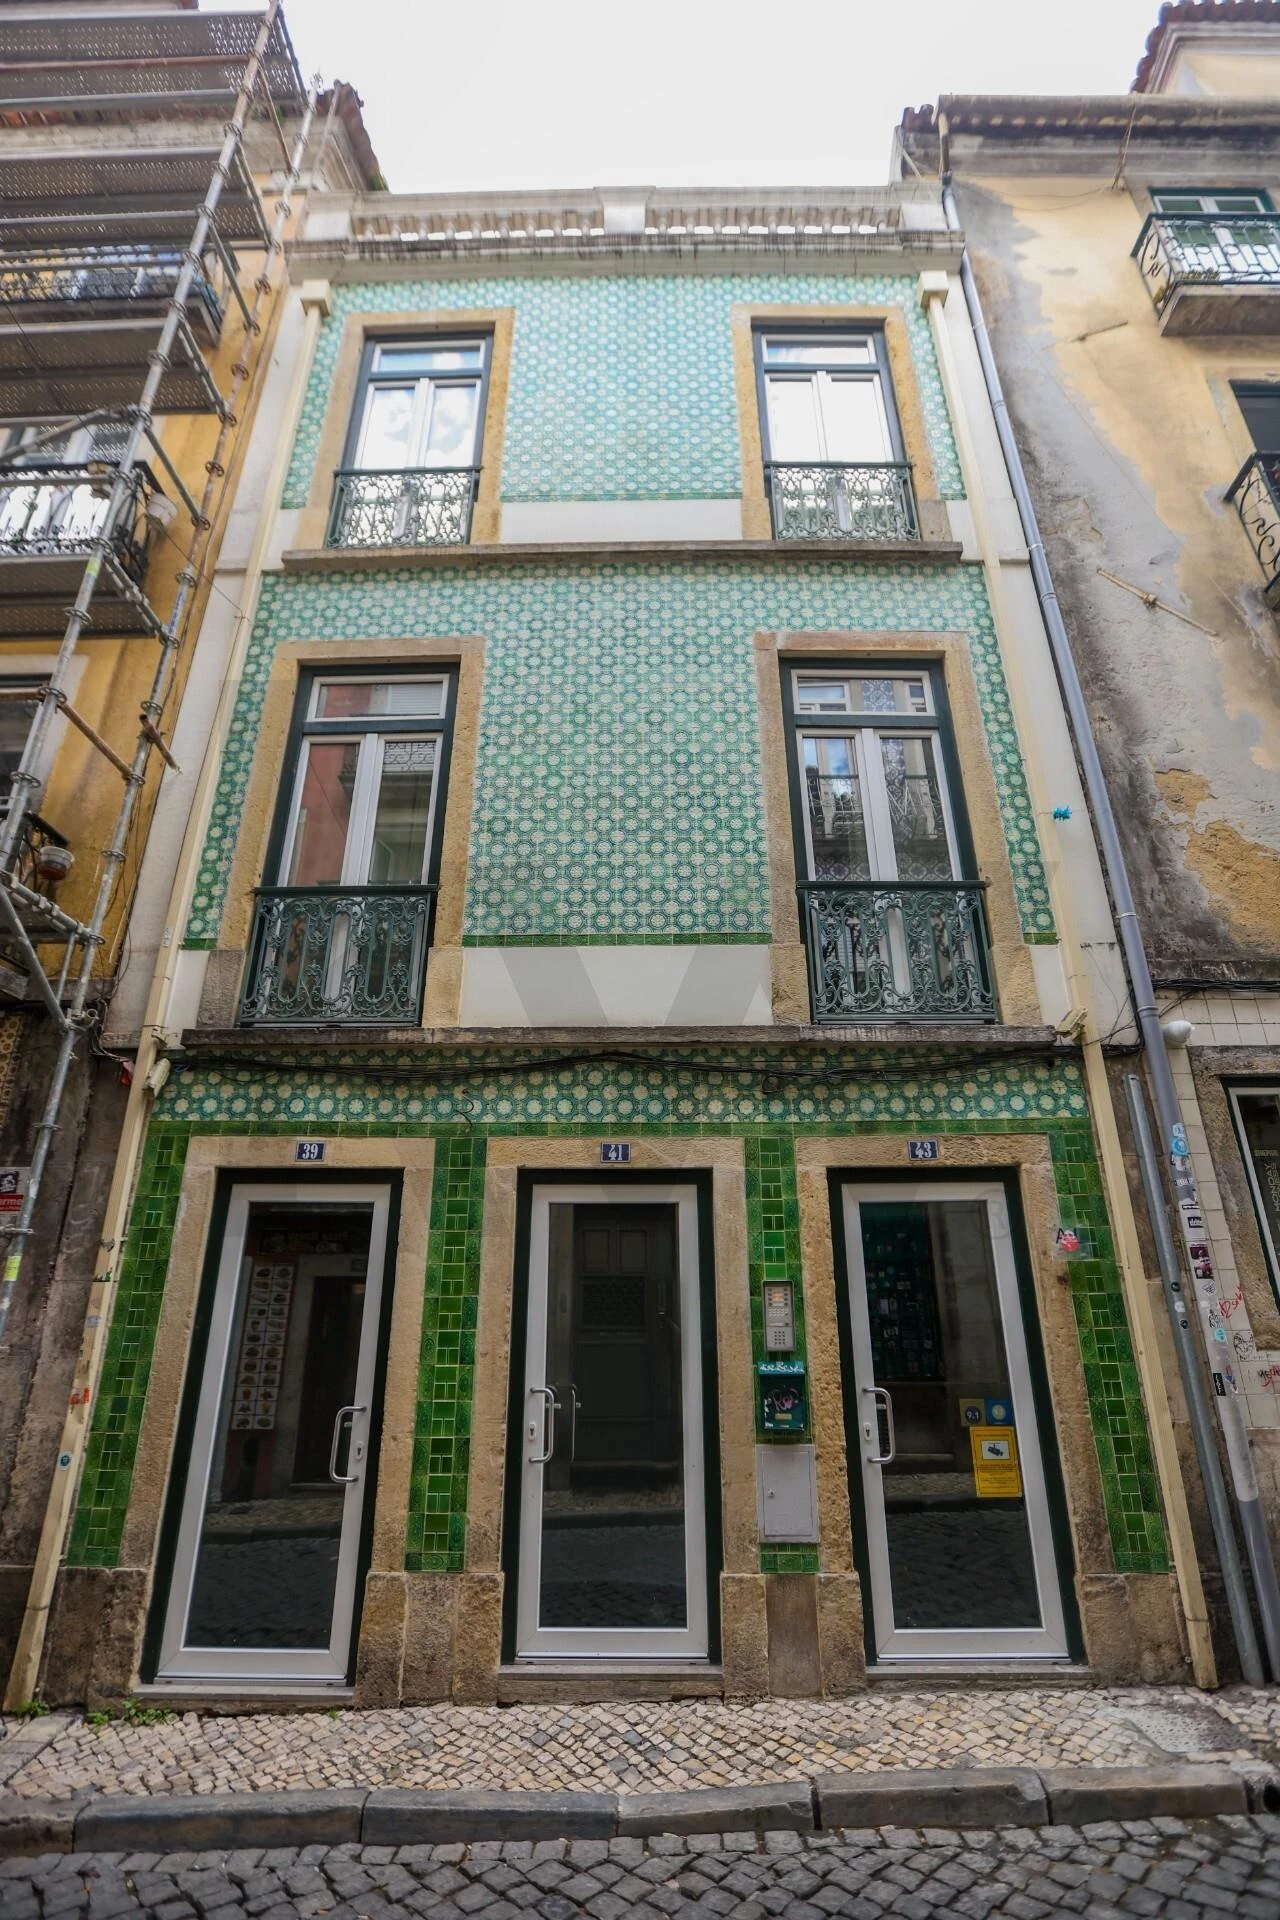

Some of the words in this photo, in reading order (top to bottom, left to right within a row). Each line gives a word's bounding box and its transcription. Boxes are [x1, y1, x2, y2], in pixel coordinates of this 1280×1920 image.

[302, 1143, 319, 1160] 39
[608, 1144, 623, 1161] 41
[915, 1142, 932, 1159] 43
